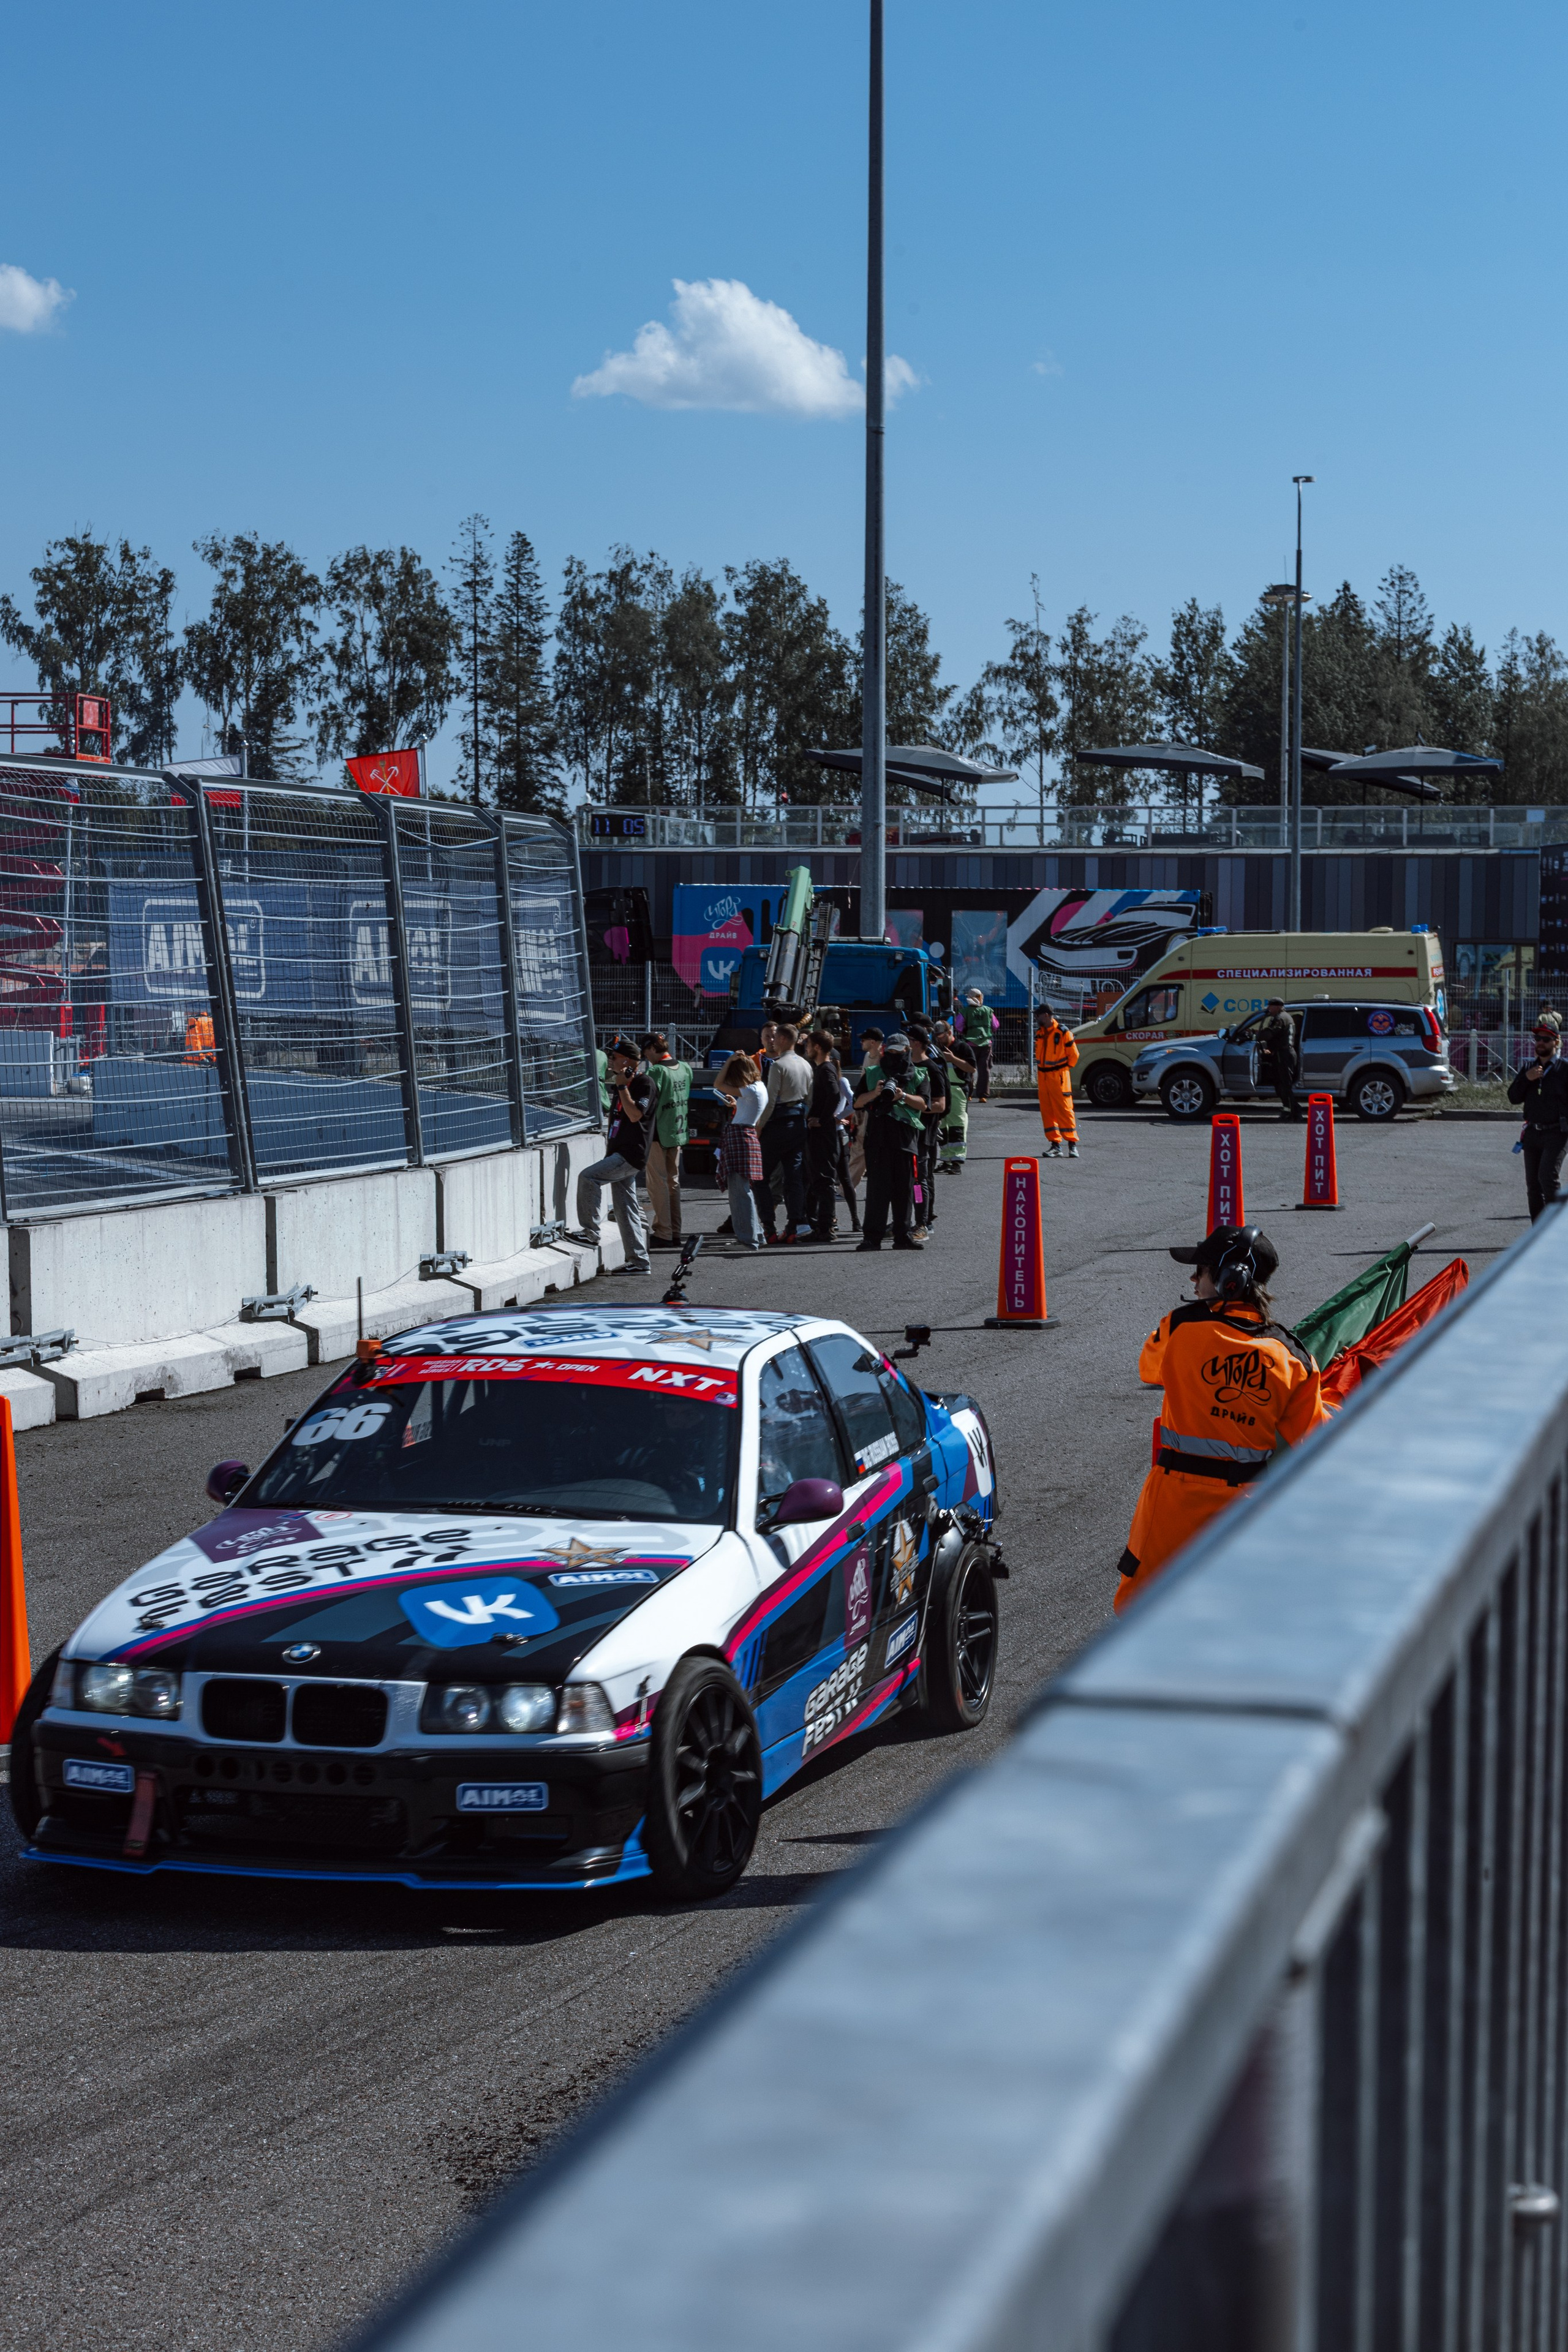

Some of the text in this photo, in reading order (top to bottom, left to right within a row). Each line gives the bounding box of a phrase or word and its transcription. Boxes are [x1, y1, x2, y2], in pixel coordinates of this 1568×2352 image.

[707, 960, 735, 980] VK
[1217, 968, 1373, 979] СПЕЦИАЛИЗИРОВАННАЯ
[1315, 1110, 1324, 1194] ХОТ ПИТ
[1220, 1134, 1231, 1225] ХОТ ПИТ
[1014, 1177, 1027, 1308] НАКОПИТЕЛЬ
[458, 1359, 534, 1372] RDS
[555, 1363, 601, 1373] OPEN
[628, 1367, 726, 1391] NXT
[291, 1403, 393, 1446] 66
[1210, 1406, 1256, 1426] ДРАЙВ
[423, 1593, 535, 1624] VK
